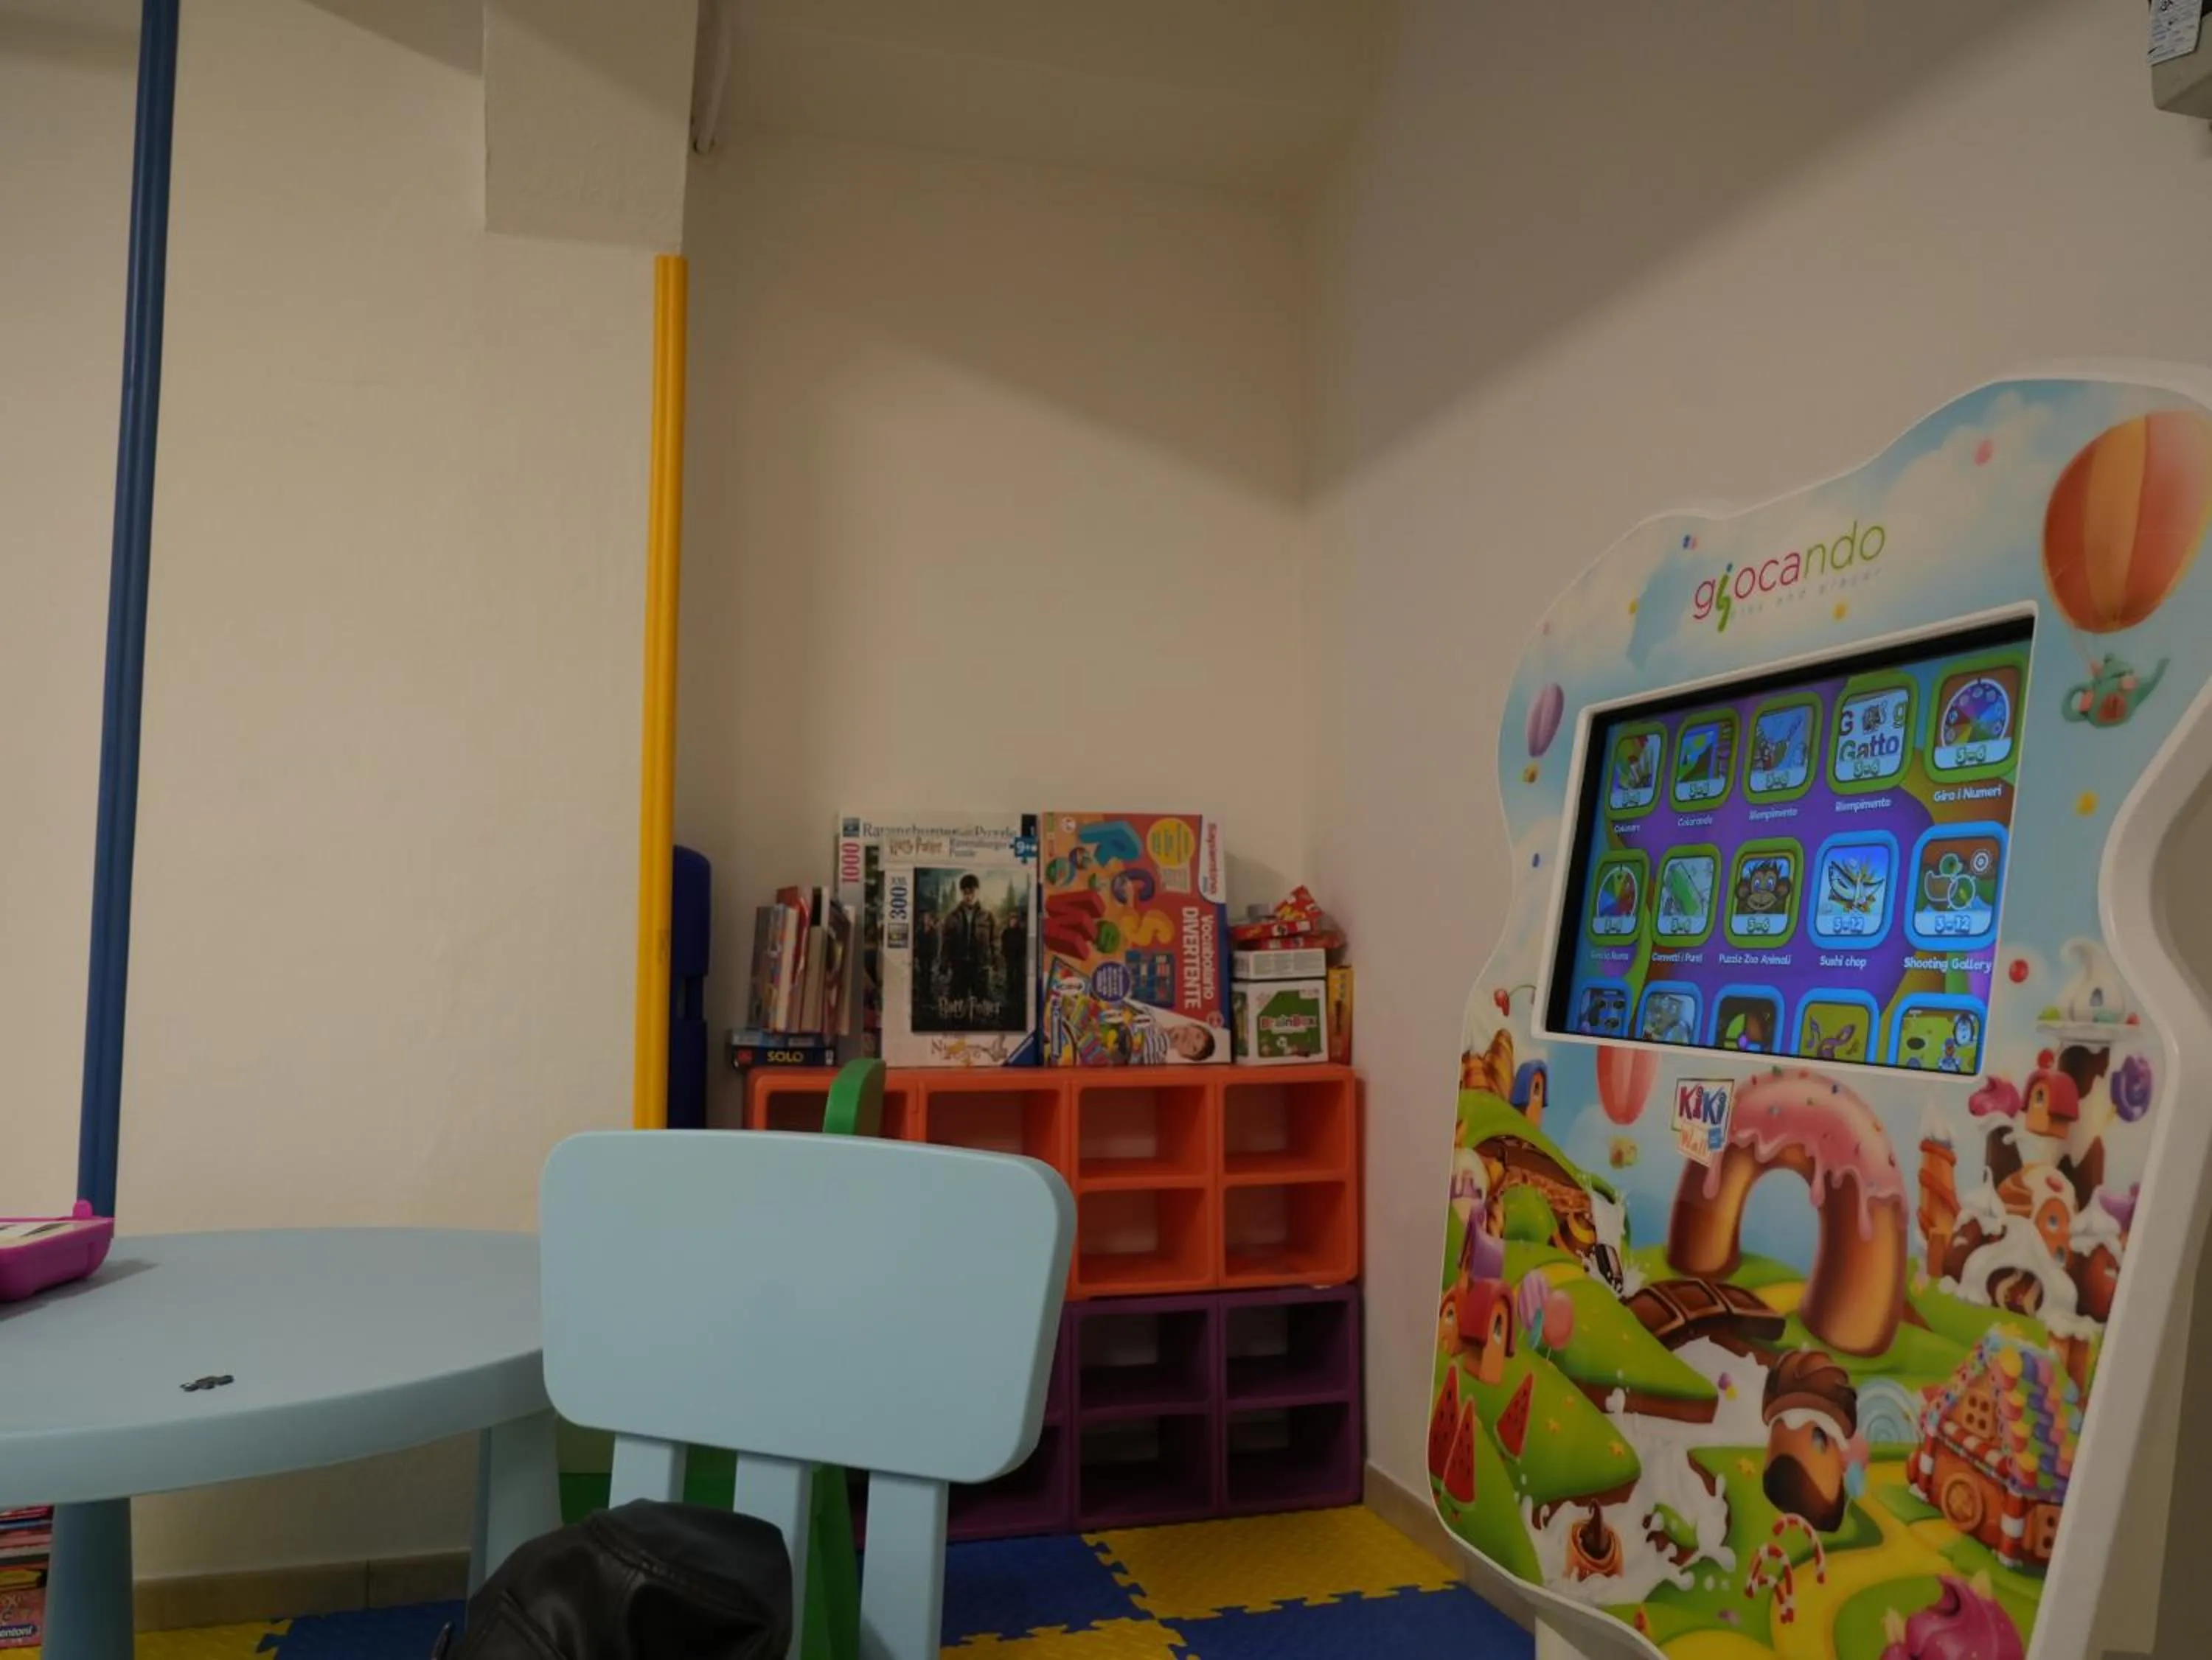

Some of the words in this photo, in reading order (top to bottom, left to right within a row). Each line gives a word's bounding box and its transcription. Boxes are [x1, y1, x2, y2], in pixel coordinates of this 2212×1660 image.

[1694, 520, 1885, 632] giocando
[1839, 732, 1900, 762] Gatto
[1933, 790, 1955, 803] Gira
[1963, 784, 2003, 800] Numeri
[842, 843, 860, 883] 1000
[890, 887, 908, 919] 300
[1182, 906, 1202, 1010] DIVERTENTE
[1200, 914, 1216, 1000] Vocabolario
[1819, 955, 1844, 967] Sushi
[1845, 956, 1867, 969] chop
[1903, 956, 1948, 972] Shooting
[1951, 958, 1992, 974] Gallery
[766, 1050, 804, 1063] SOLO
